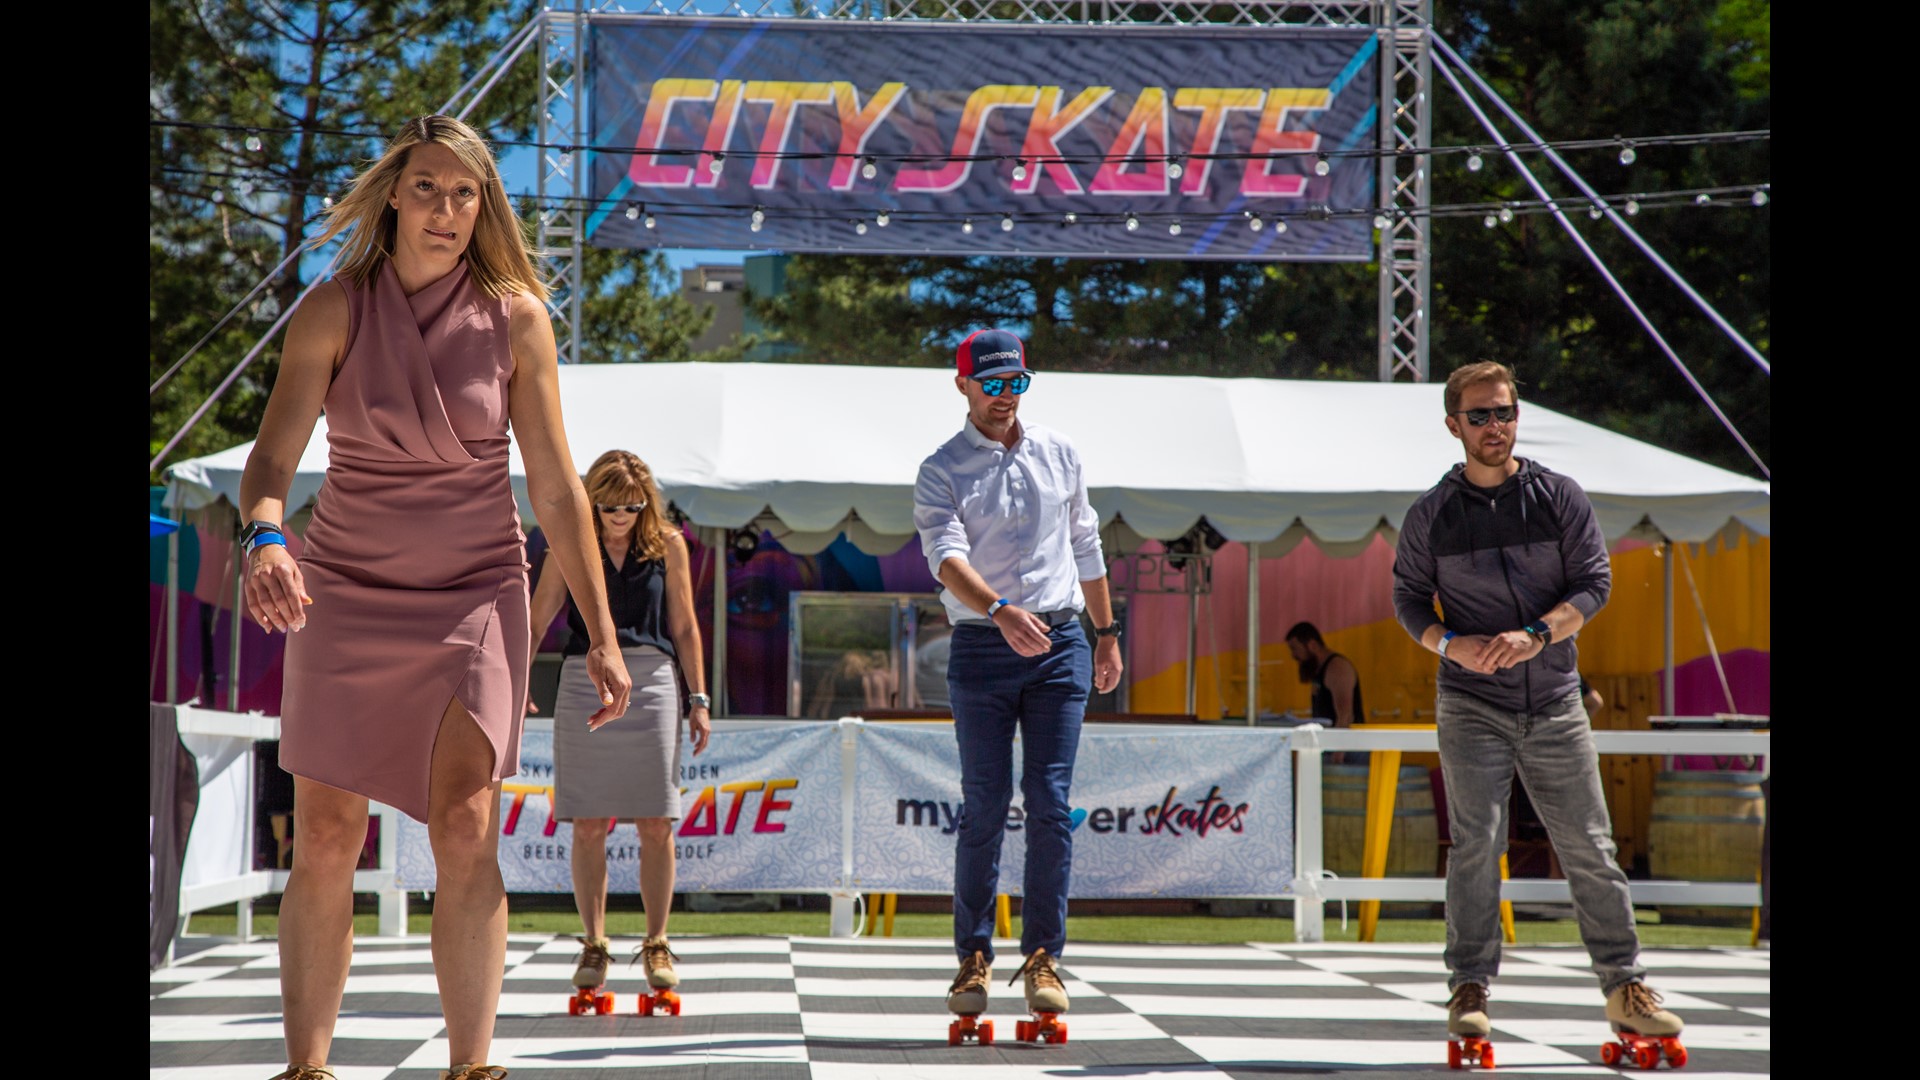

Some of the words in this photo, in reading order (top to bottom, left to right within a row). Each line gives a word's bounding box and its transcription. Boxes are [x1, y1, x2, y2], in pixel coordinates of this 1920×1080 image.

[628, 78, 909, 191] CITY
[892, 84, 1334, 198] SKATE
[680, 764, 719, 780] RDEN
[500, 783, 557, 837] TY
[608, 779, 799, 837] ATE
[1138, 785, 1250, 839] skates
[523, 844, 566, 860] BEER
[606, 845, 642, 860] KAT
[675, 844, 715, 860] GOLF
